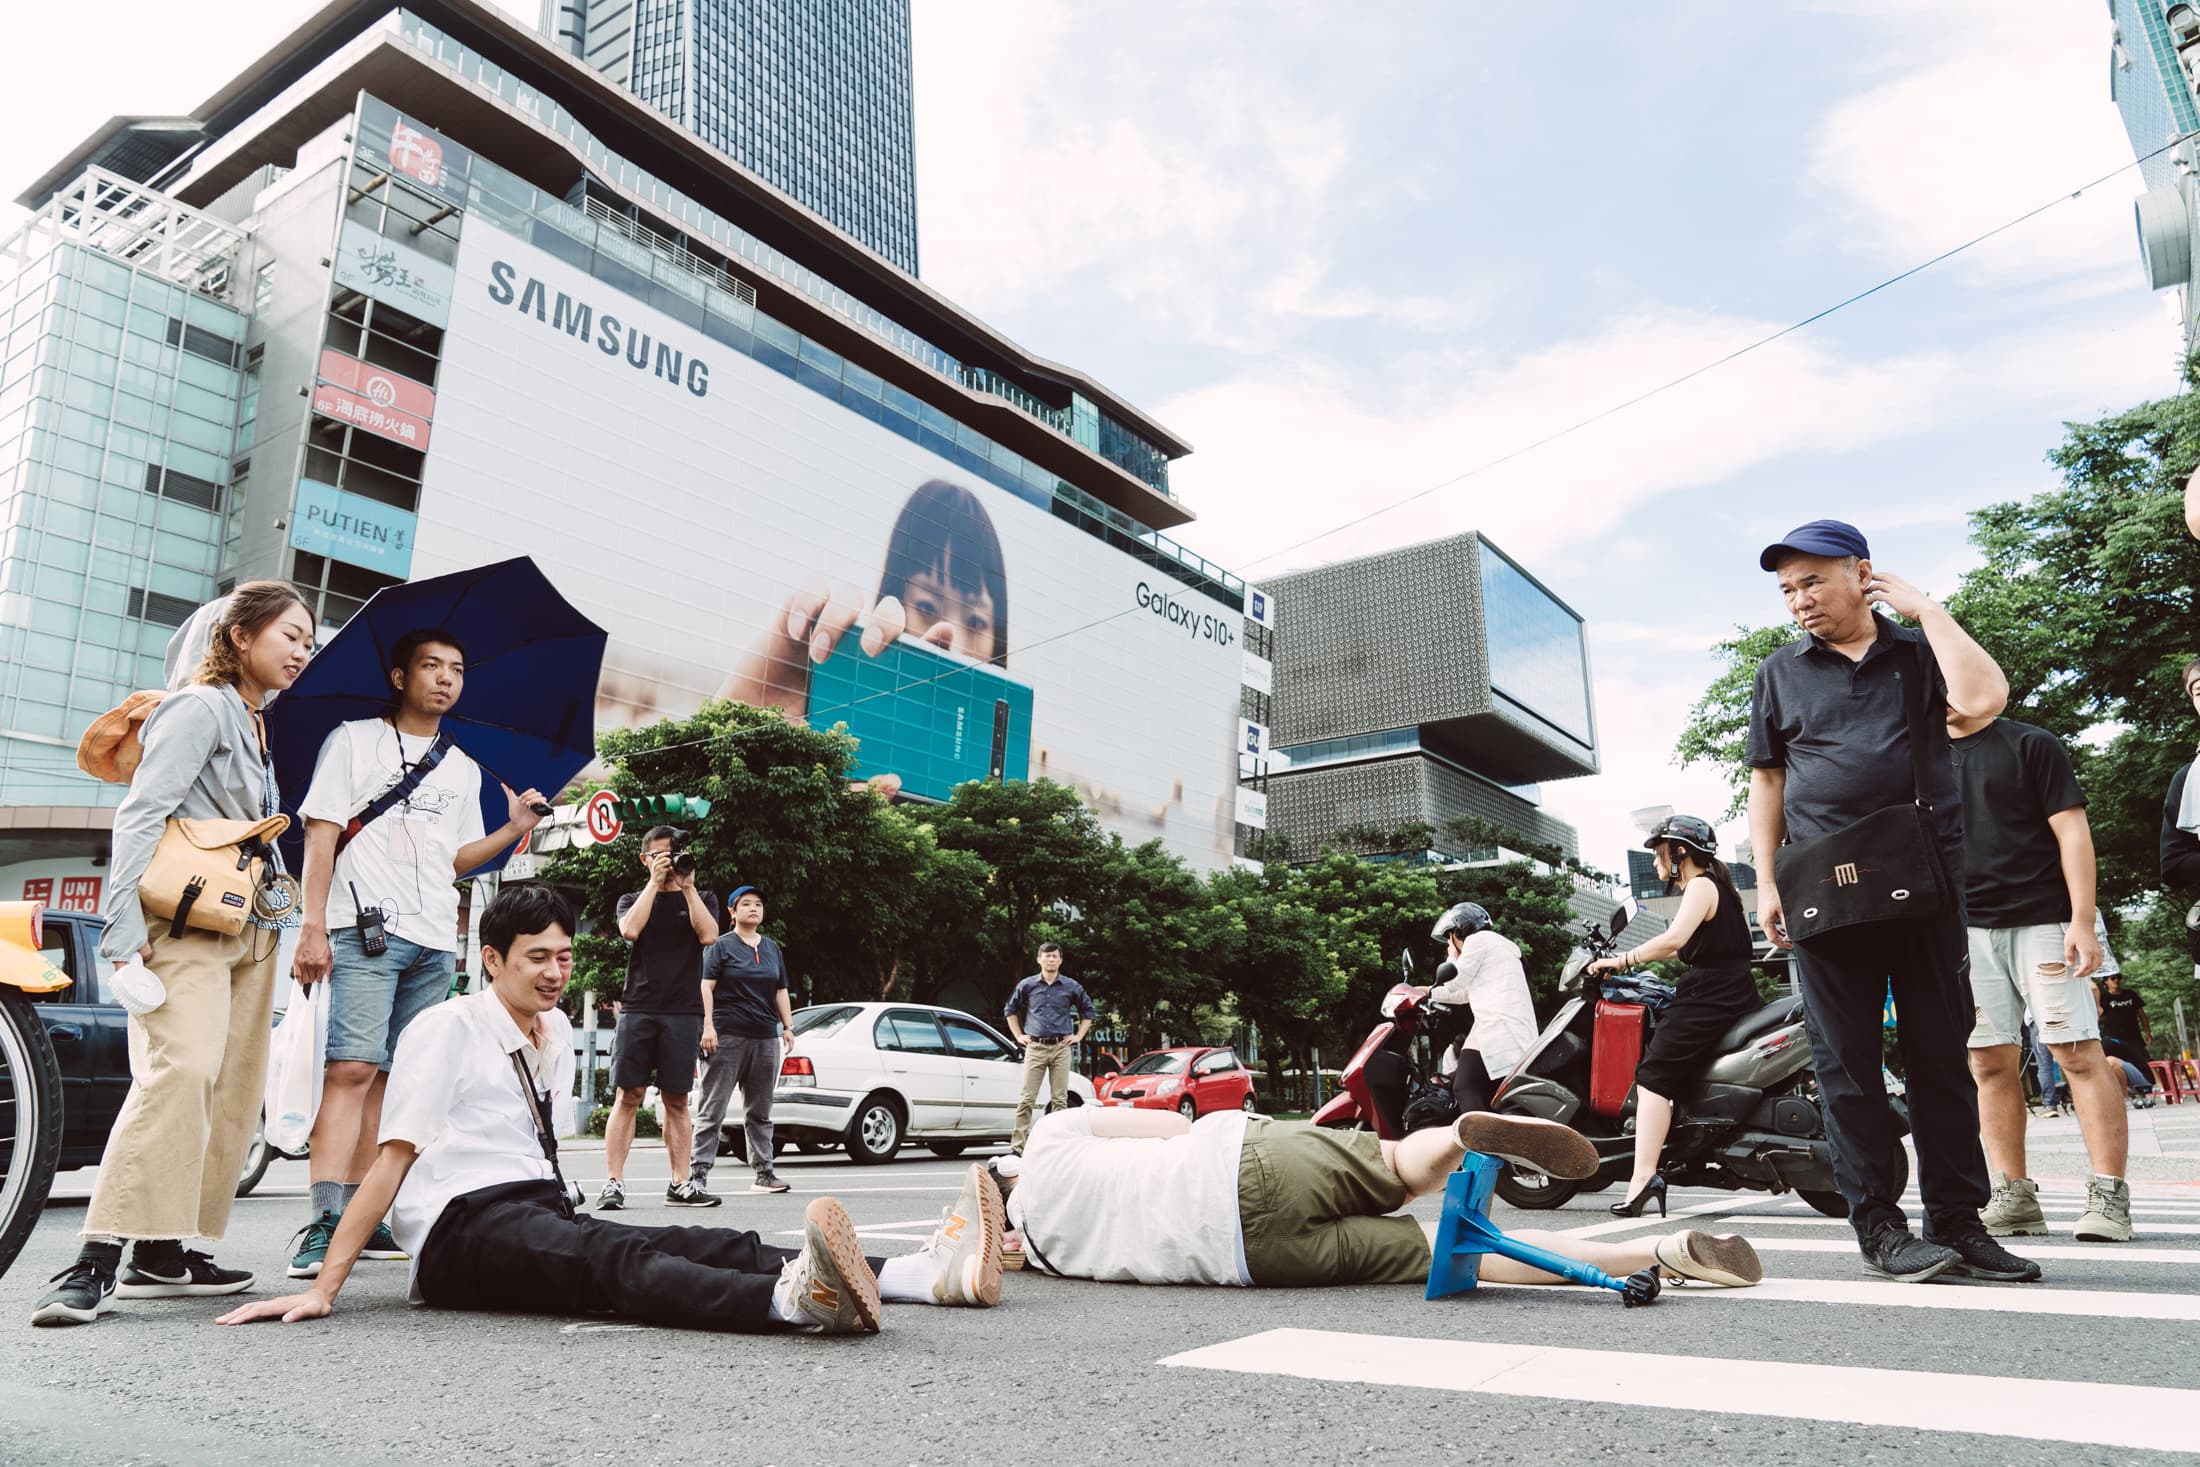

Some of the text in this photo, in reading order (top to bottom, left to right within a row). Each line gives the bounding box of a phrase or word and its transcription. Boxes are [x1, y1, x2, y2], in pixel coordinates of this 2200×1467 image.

[488, 260, 709, 397] SAMSUNG
[317, 400, 333, 413] 6F
[335, 398, 416, 441] 海底撈火鍋
[307, 504, 388, 544] PUTIEN
[1136, 581, 1234, 647] Galaxy S10+
[954, 706, 965, 760] SAMSUNG
[1247, 732, 1260, 748] GU
[64, 881, 95, 897] UNI
